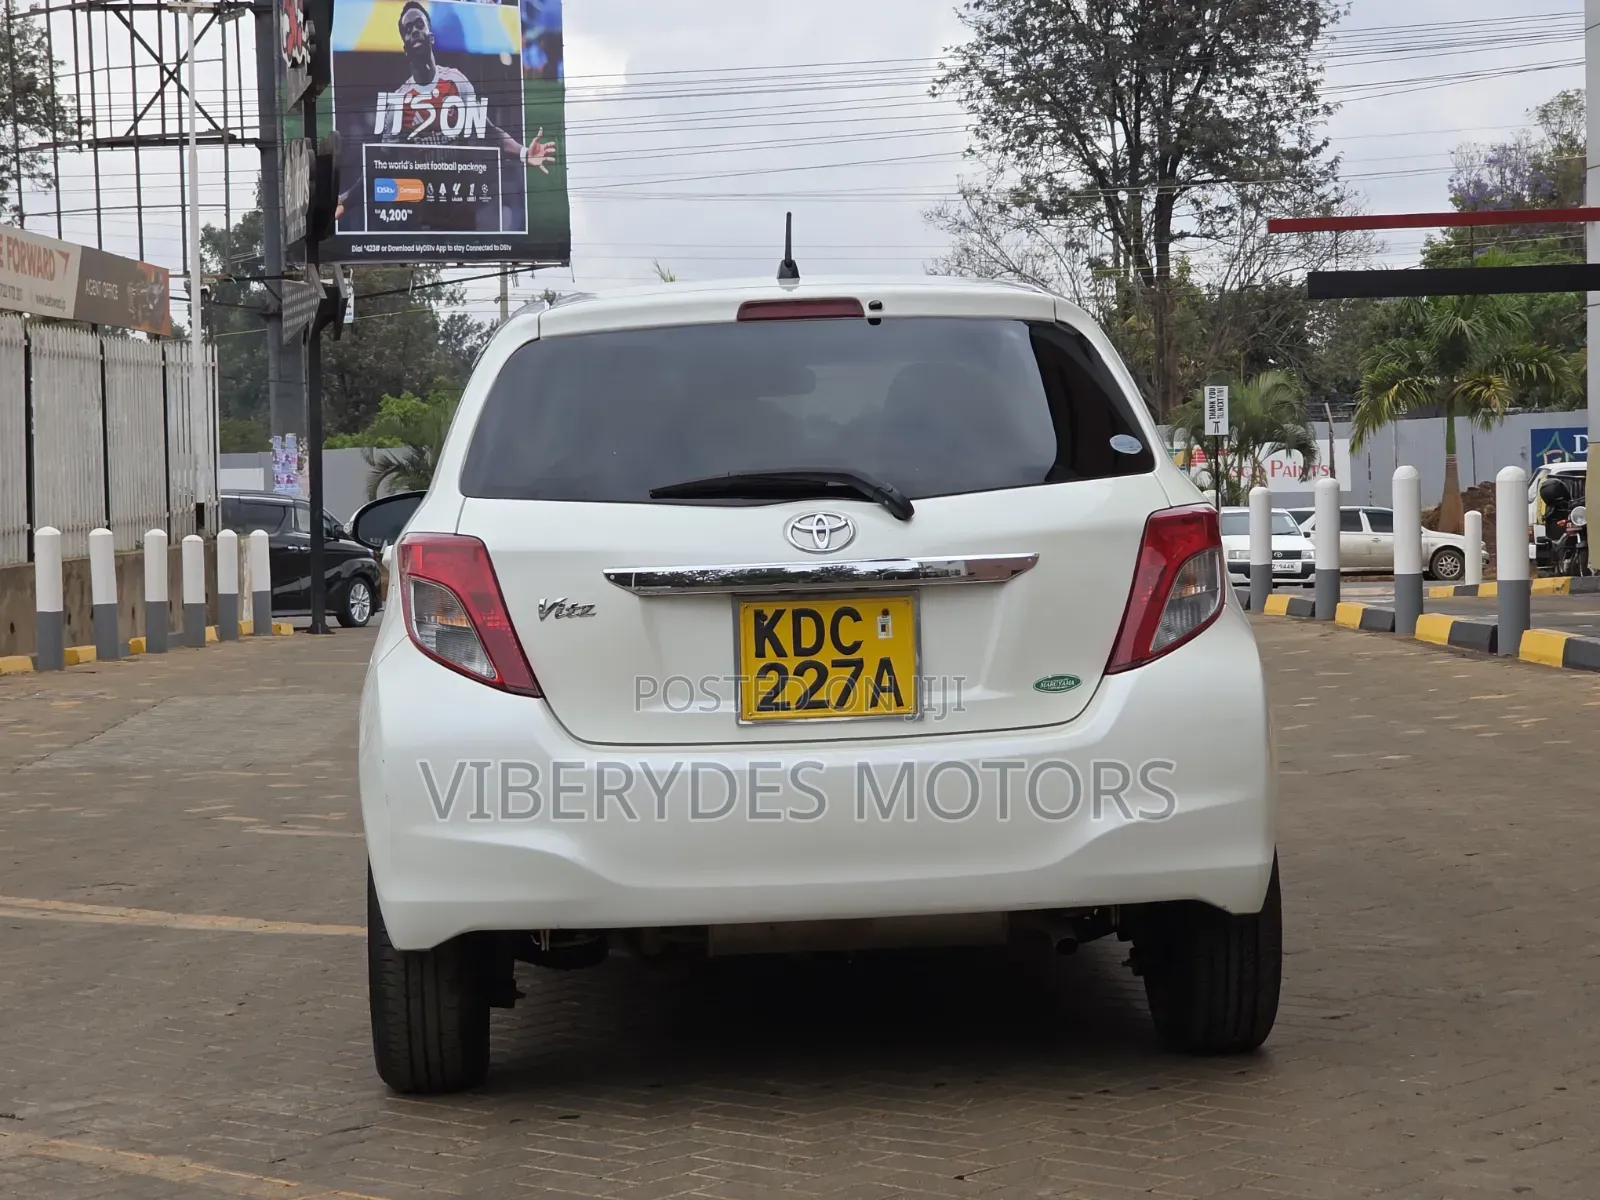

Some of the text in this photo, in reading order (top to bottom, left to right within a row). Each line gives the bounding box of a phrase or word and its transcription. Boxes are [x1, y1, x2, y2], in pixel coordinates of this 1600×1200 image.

[374, 92, 488, 140] IT'S ON
[374, 160, 487, 174] The world's best football package
[7, 235, 56, 281] FORWARD
[351, 244, 363, 252] Dial
[387, 244, 415, 252] Download
[436, 244, 447, 253] App
[453, 244, 465, 253] stay
[465, 244, 493, 252] Connected
[85, 277, 118, 300] AGENT OFFICE
[1208, 387, 1216, 420] THANK YOU
[1216, 398, 1224, 411] NEXT
[538, 597, 597, 622] Vitz
[753, 606, 863, 659] KDC
[755, 656, 904, 712] 227A
